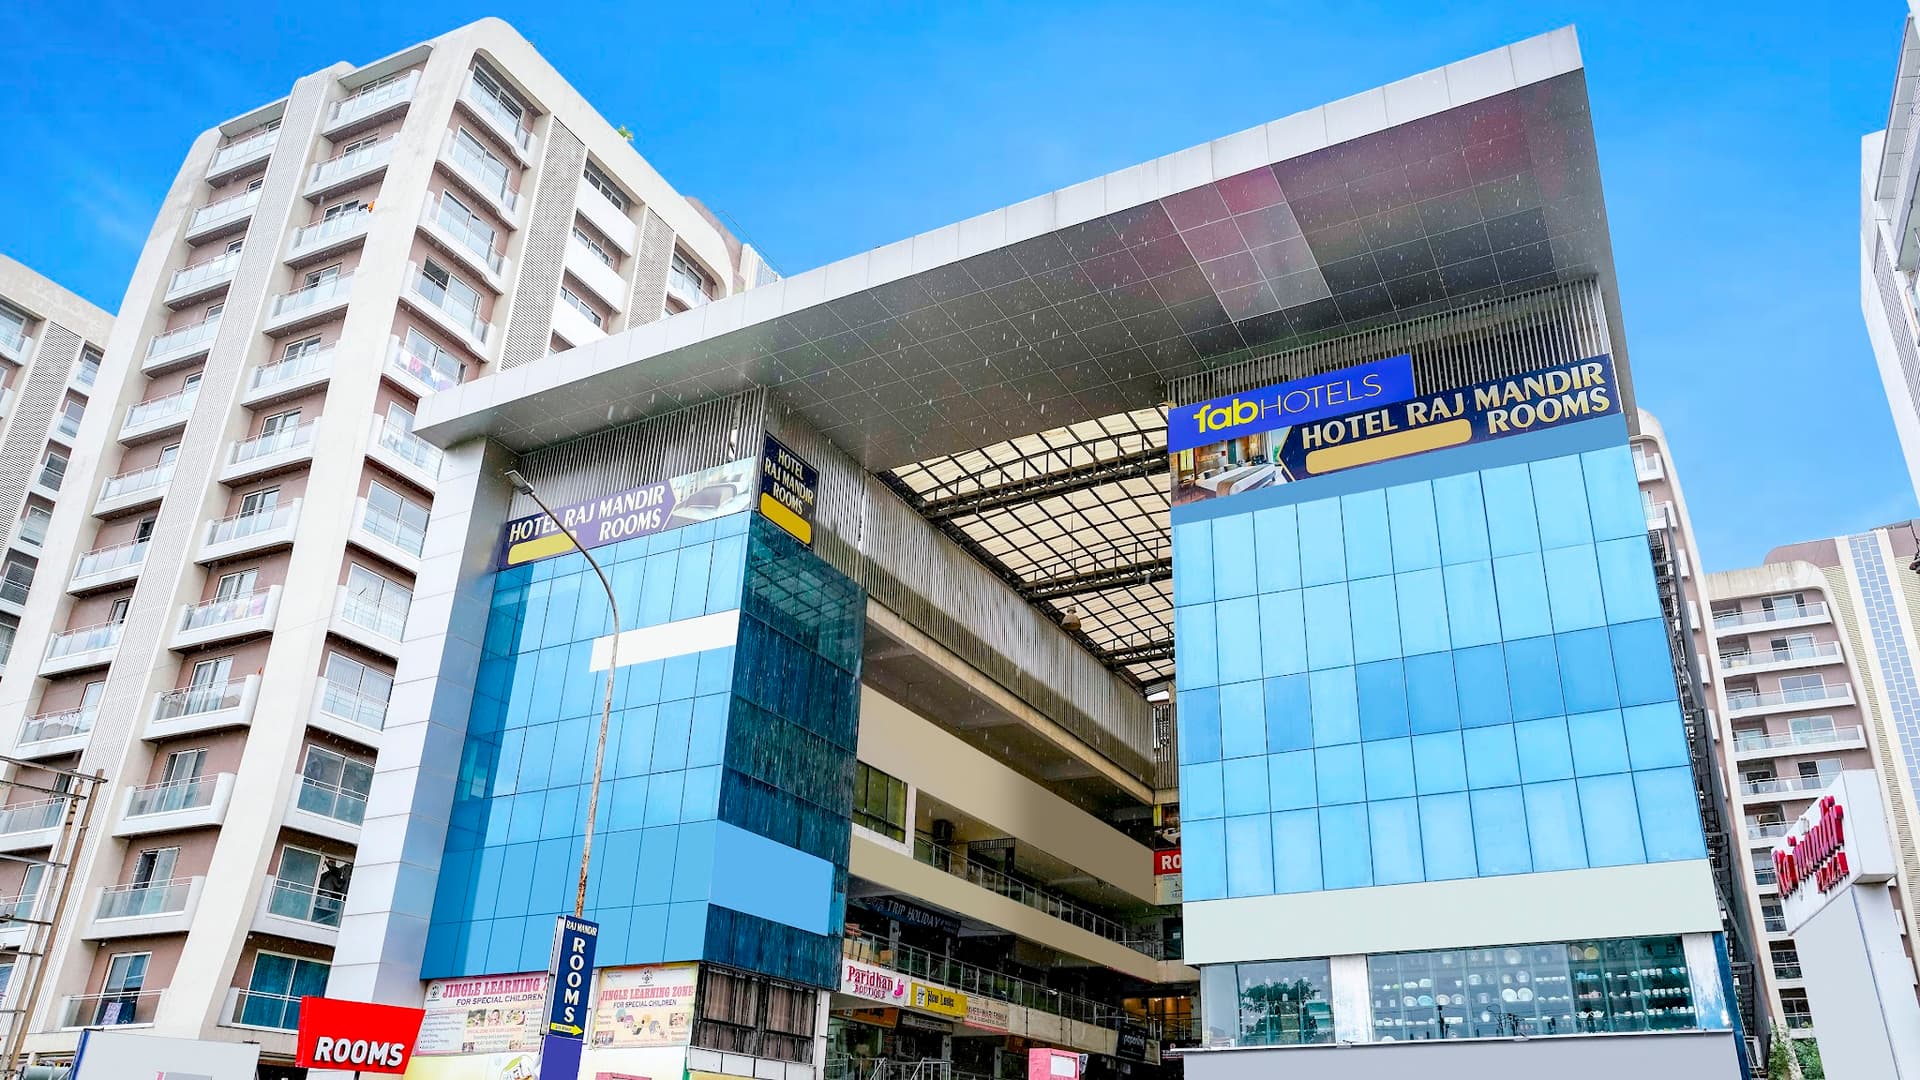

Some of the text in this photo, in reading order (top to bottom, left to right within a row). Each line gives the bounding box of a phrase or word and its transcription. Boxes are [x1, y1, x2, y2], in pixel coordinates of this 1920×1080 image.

[1193, 373, 1383, 434] fabHOTELS
[1301, 362, 1606, 450] HOTEL RAJ MANDIR
[1486, 386, 1611, 435] ROOMS
[777, 449, 805, 481] HOTEL
[763, 462, 815, 505] RAJ MANDIR
[508, 484, 666, 543] HOTEL RAJ MANDIR
[772, 484, 805, 516] ROOMS
[598, 507, 662, 542] ROOMS
[566, 920, 598, 937] RAJ MANDIR
[442, 981, 482, 998] JINGLE
[483, 977, 541, 995] LEARNING
[563, 936, 586, 1023] ROOMS
[600, 985, 694, 1001] JINGLE LEARNING ZONE
[847, 965, 893, 991] Paridhan
[456, 993, 544, 1006] FOR SPECIAL CHILDREN
[613, 999, 677, 1009] FOR SPECIAL CHILDREN
[313, 1036, 405, 1067] ROOMS
